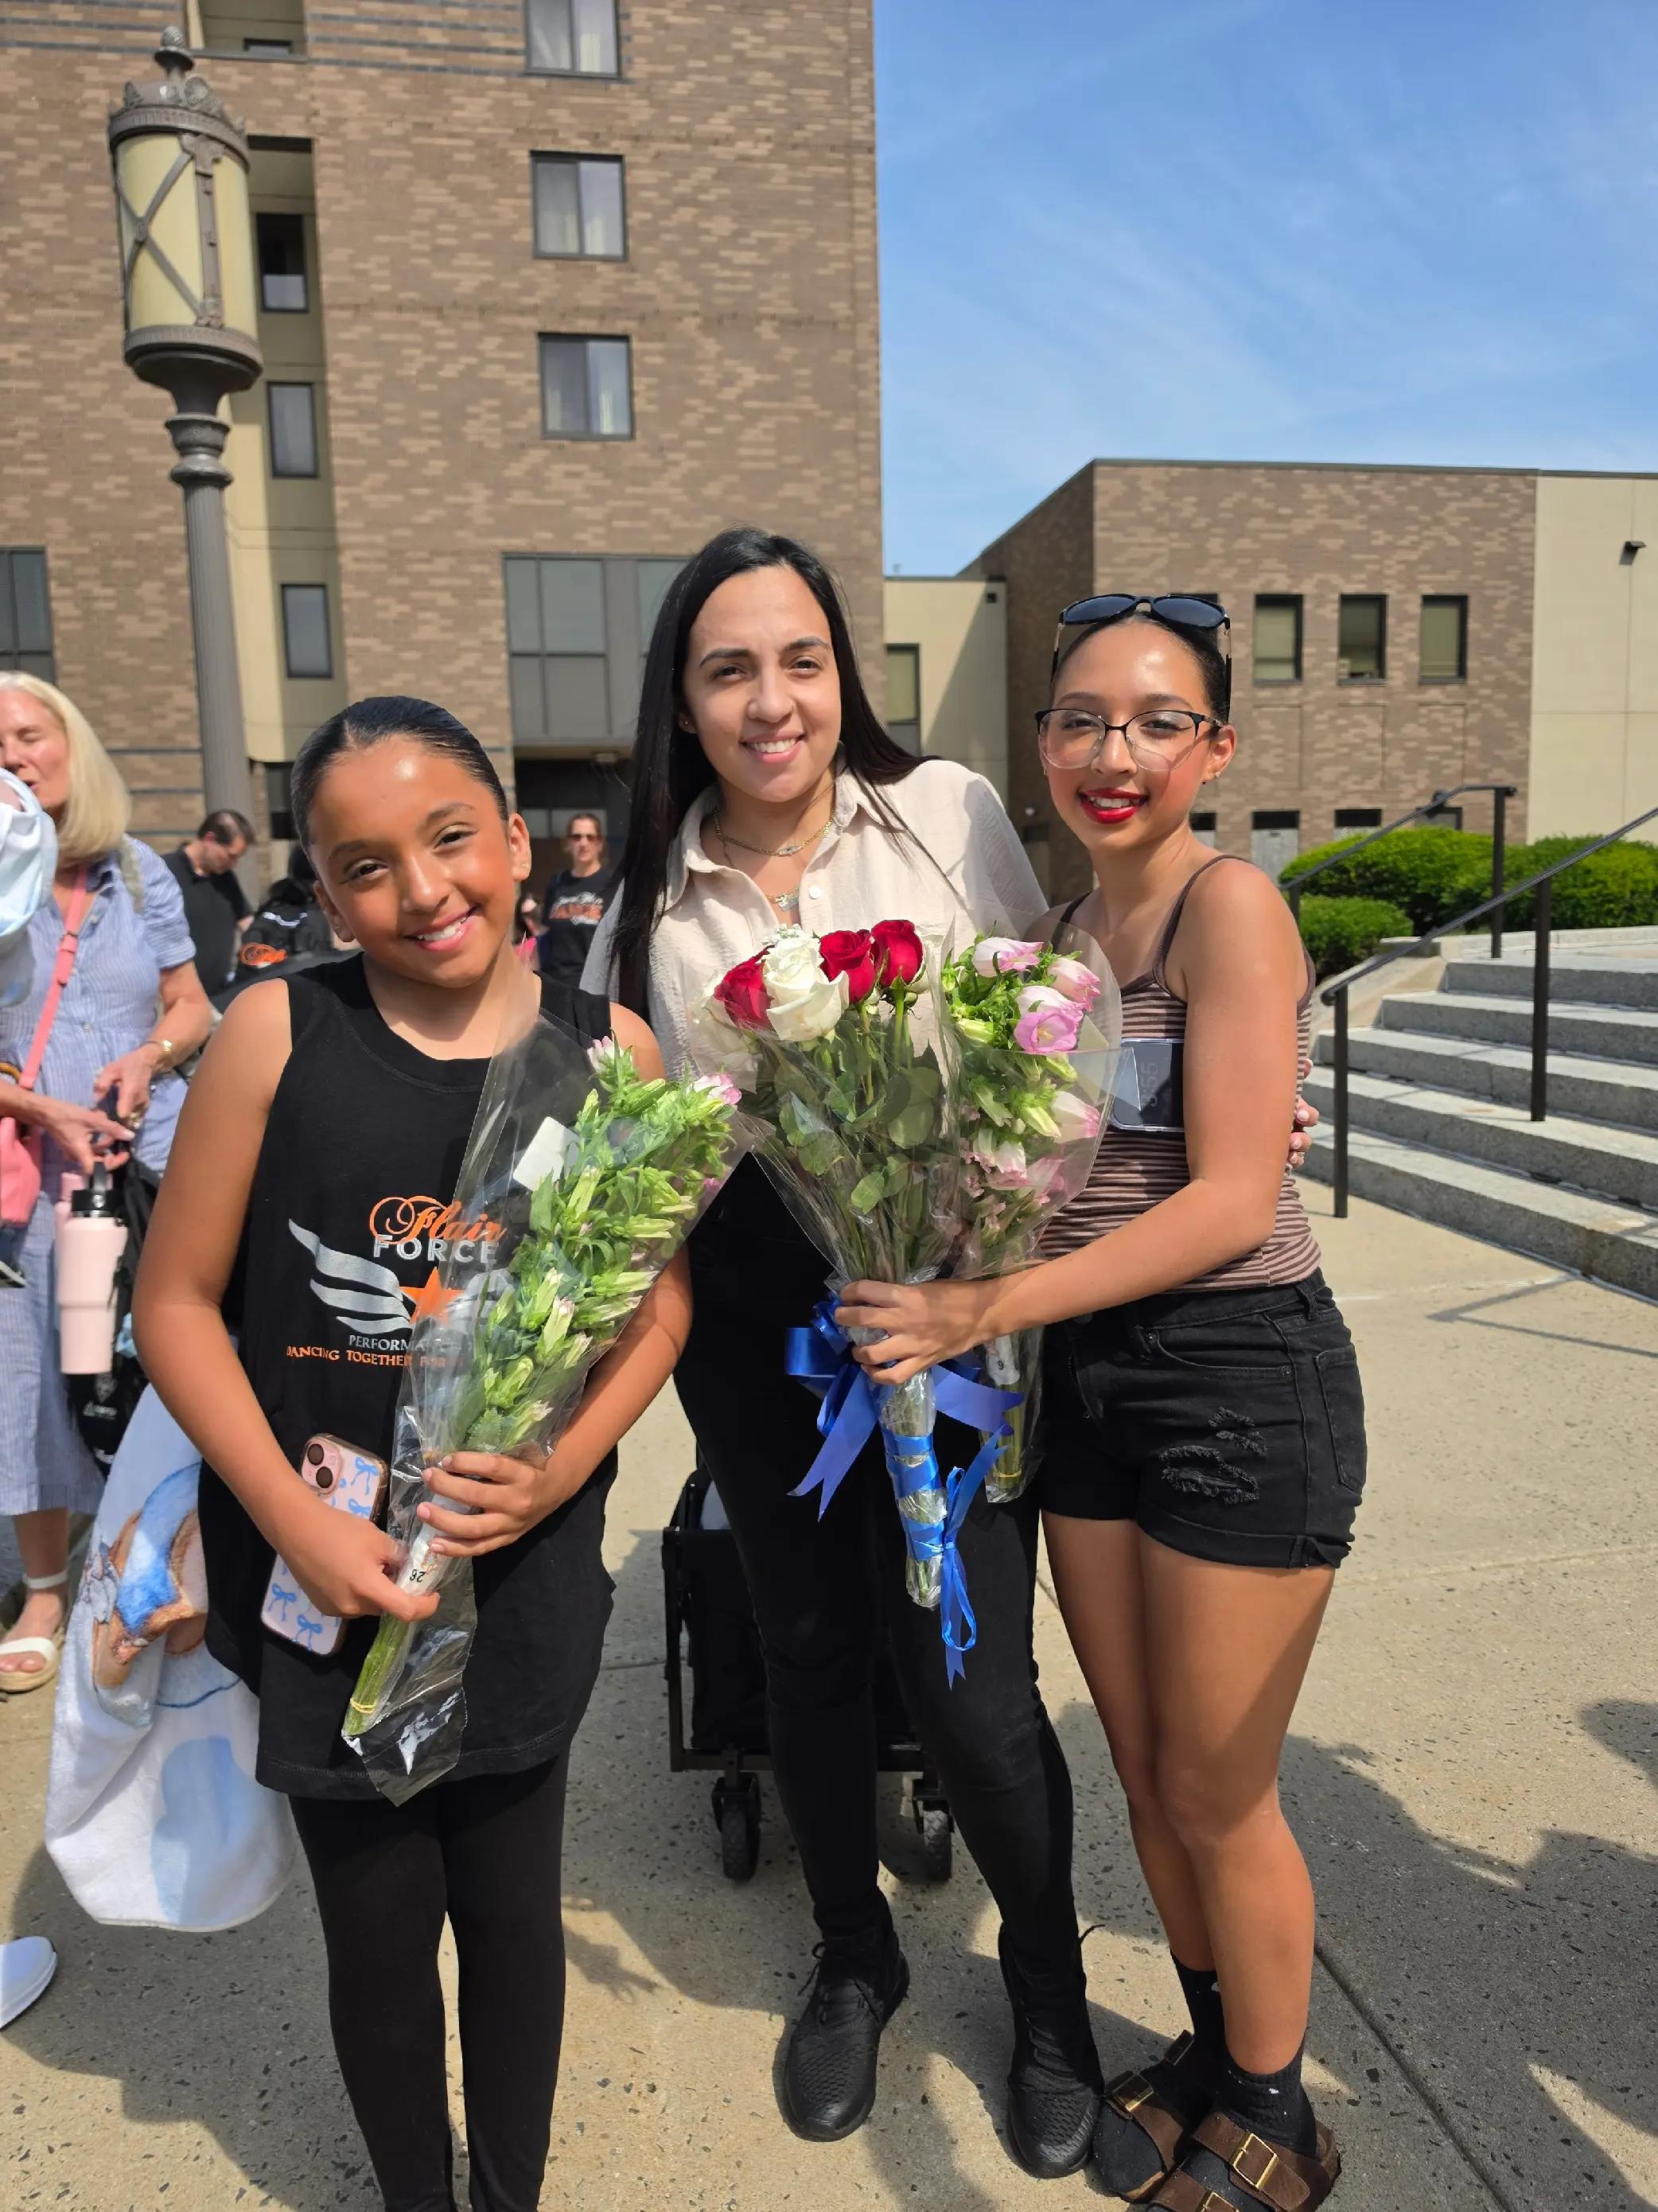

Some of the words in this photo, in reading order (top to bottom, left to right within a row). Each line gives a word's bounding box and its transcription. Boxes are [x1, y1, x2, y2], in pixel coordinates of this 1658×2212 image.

[369, 1195, 507, 1244] Flair
[373, 1234, 497, 1264] FORCE
[345, 1349, 412, 1367] TOGETHER
